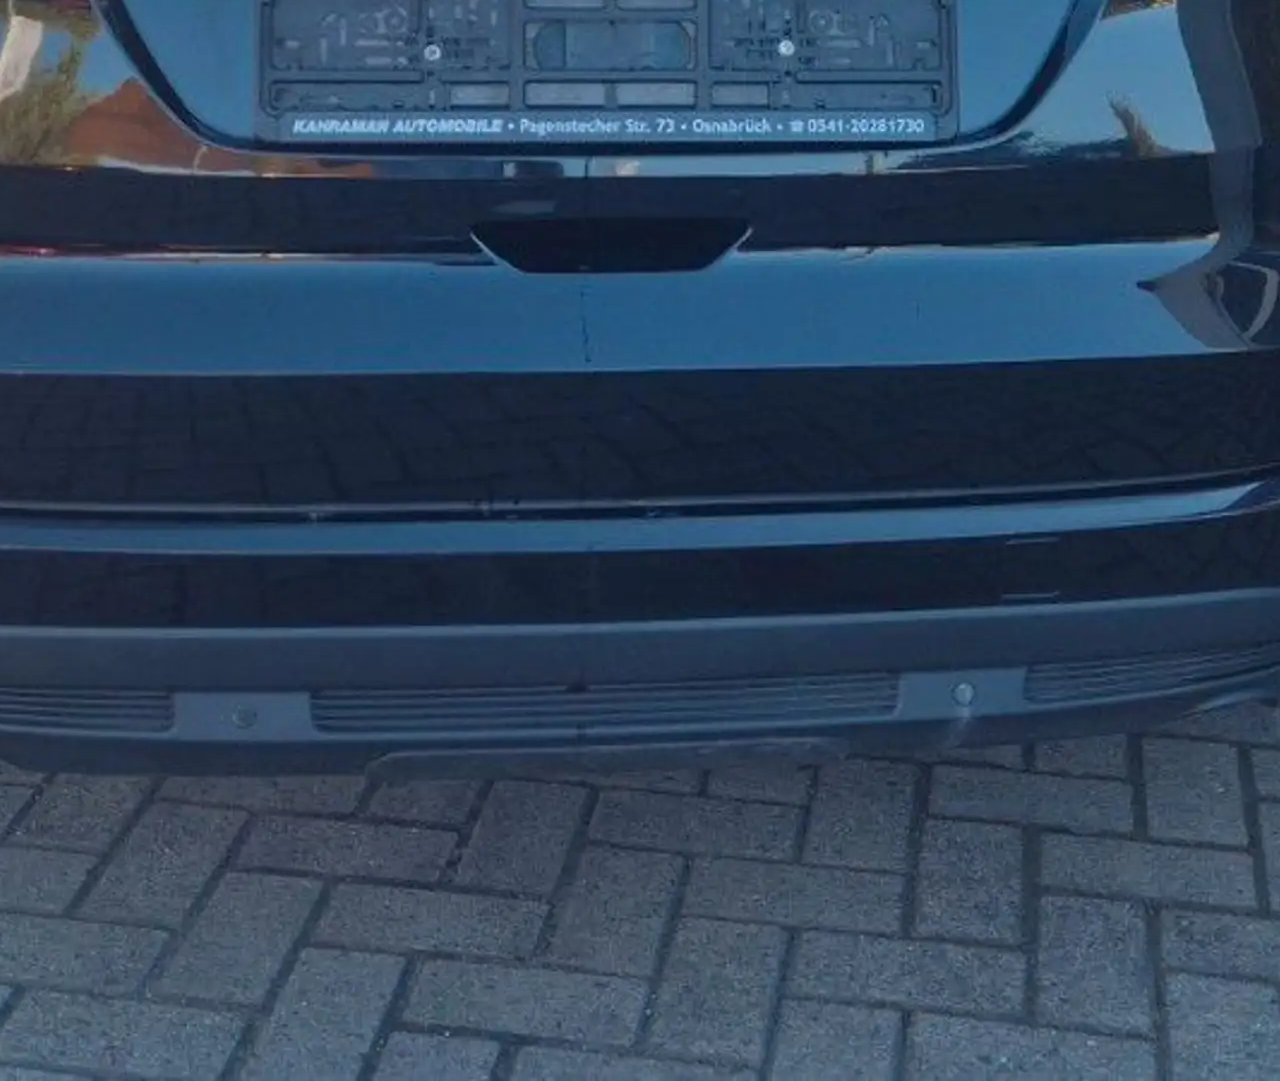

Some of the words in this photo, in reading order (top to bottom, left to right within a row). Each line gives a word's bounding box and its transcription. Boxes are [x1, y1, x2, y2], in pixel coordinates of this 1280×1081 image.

[393, 118, 504, 133] AUTOMOBILE
[519, 118, 622, 136] Pagenstecher
[625, 118, 651, 133] Str.
[656, 118, 676, 133] 73
[692, 118, 772, 133] Osnabrück
